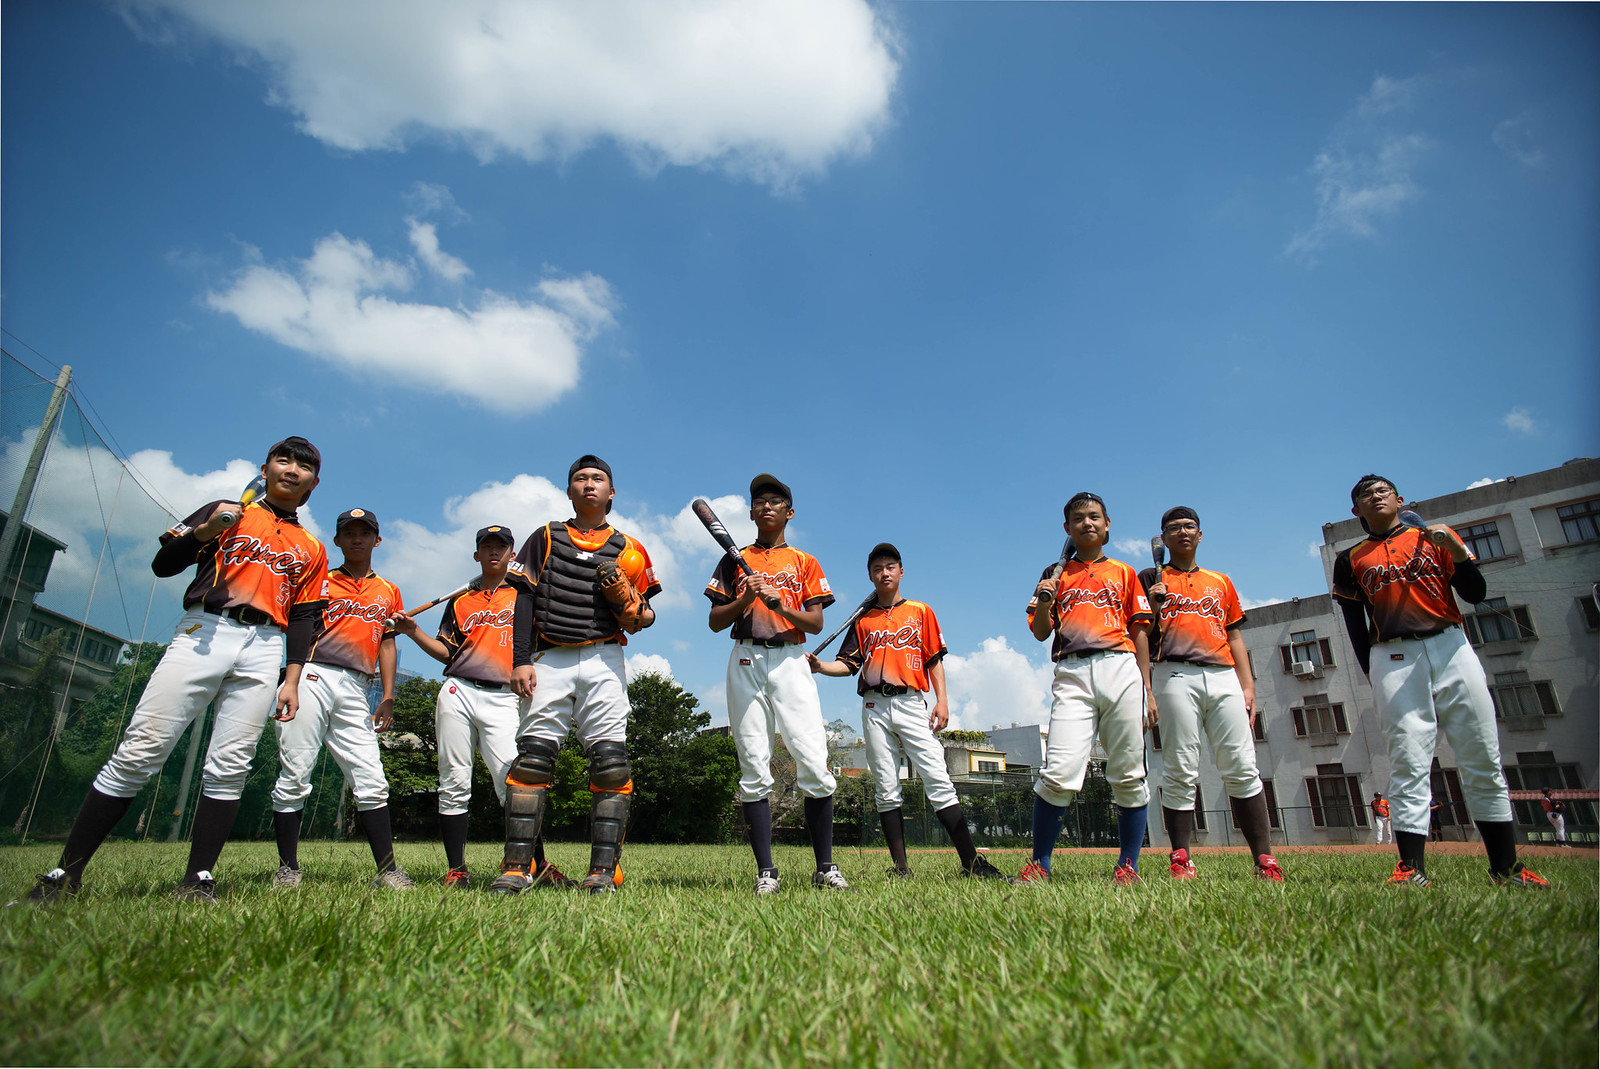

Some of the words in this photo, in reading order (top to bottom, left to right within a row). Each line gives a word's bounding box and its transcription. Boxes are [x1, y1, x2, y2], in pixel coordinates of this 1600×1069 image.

[463, 609, 514, 635] HsinCh
[1104, 612, 1120, 629] 11
[499, 630, 514, 648] 1
[906, 653, 922, 671] 16
